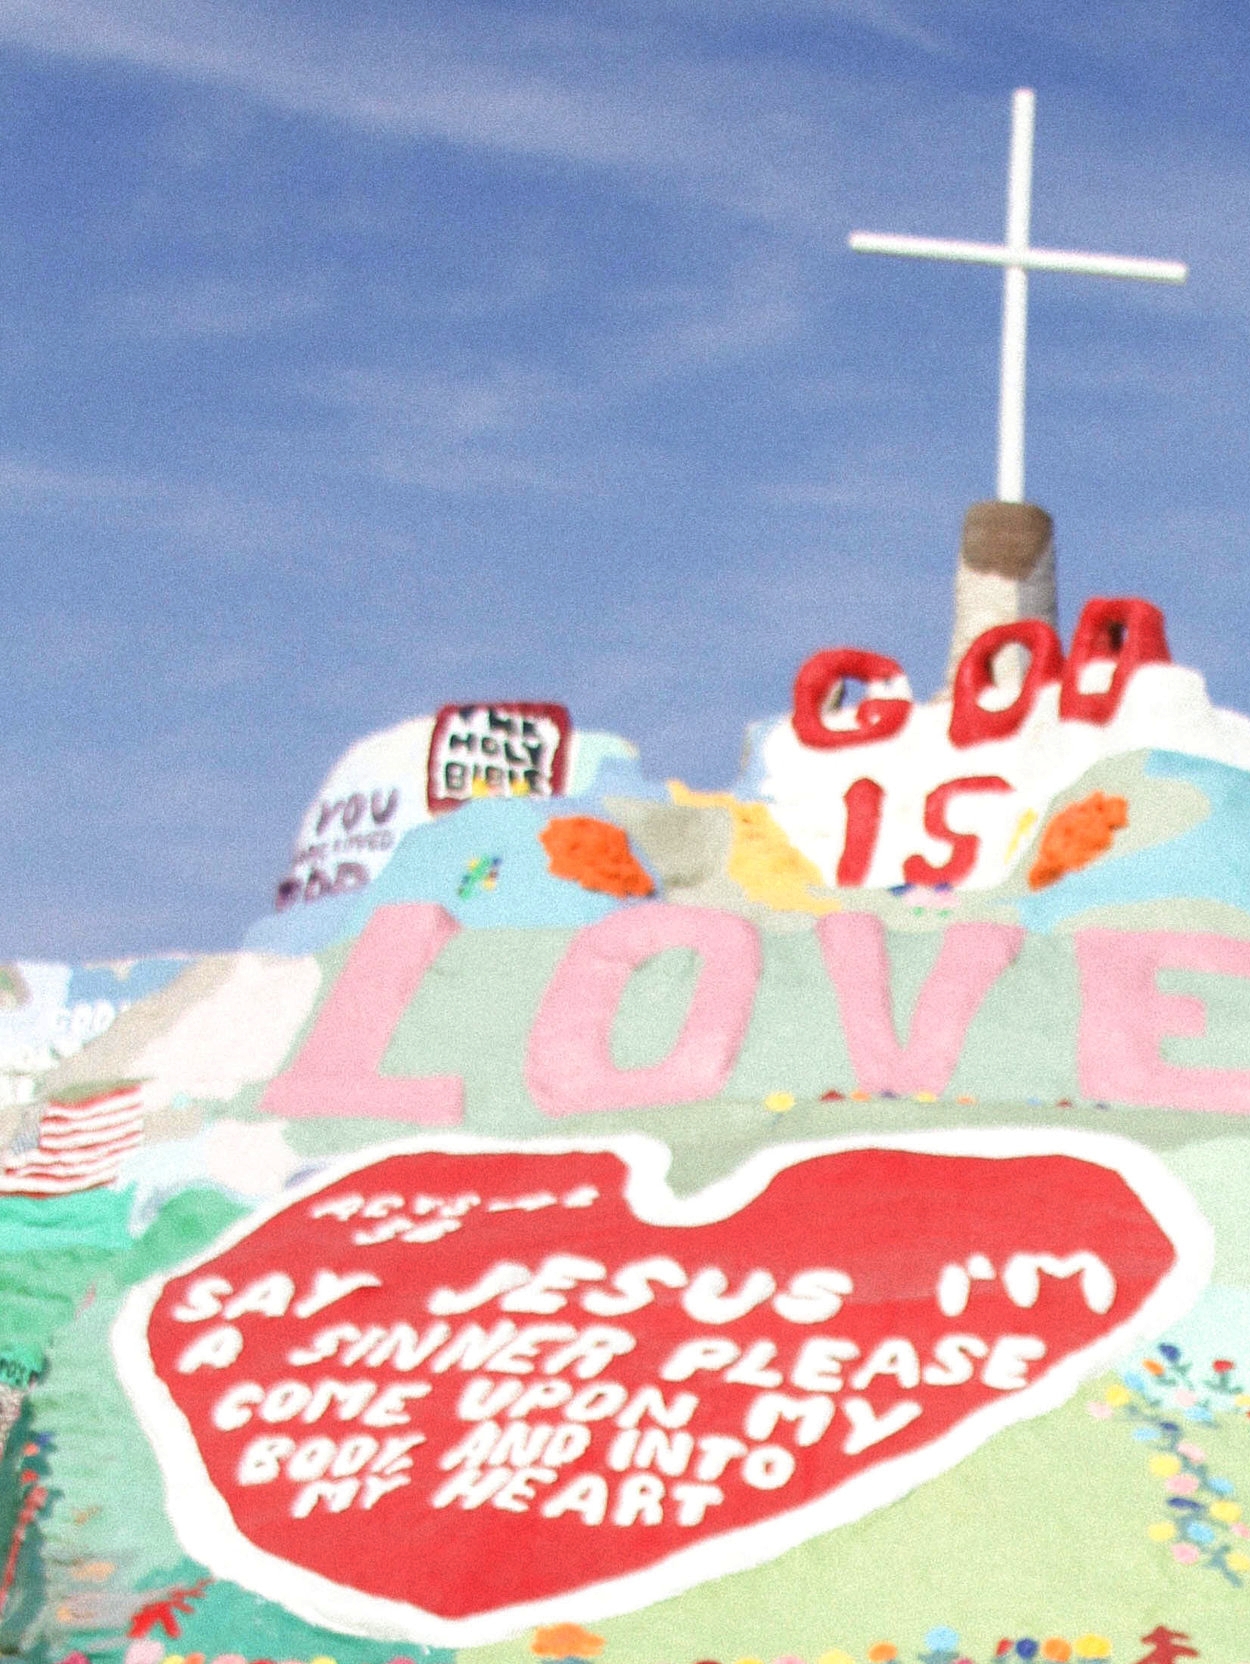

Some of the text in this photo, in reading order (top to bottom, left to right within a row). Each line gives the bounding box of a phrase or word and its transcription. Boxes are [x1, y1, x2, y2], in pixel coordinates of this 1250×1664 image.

[449, 732, 544, 767] HOLY
[315, 787, 400, 837] YOU
[836, 775, 1017, 889] IS
[173, 1250, 1118, 1326] SAY JESUS I'M
[176, 1319, 1047, 1394] A SINNER PLEASE
[212, 1377, 924, 1456] COME UPON MY
[438, 1419, 593, 1471] AND
[607, 1426, 796, 1491] INTO
[290, 1466, 725, 1528] MY HEART
